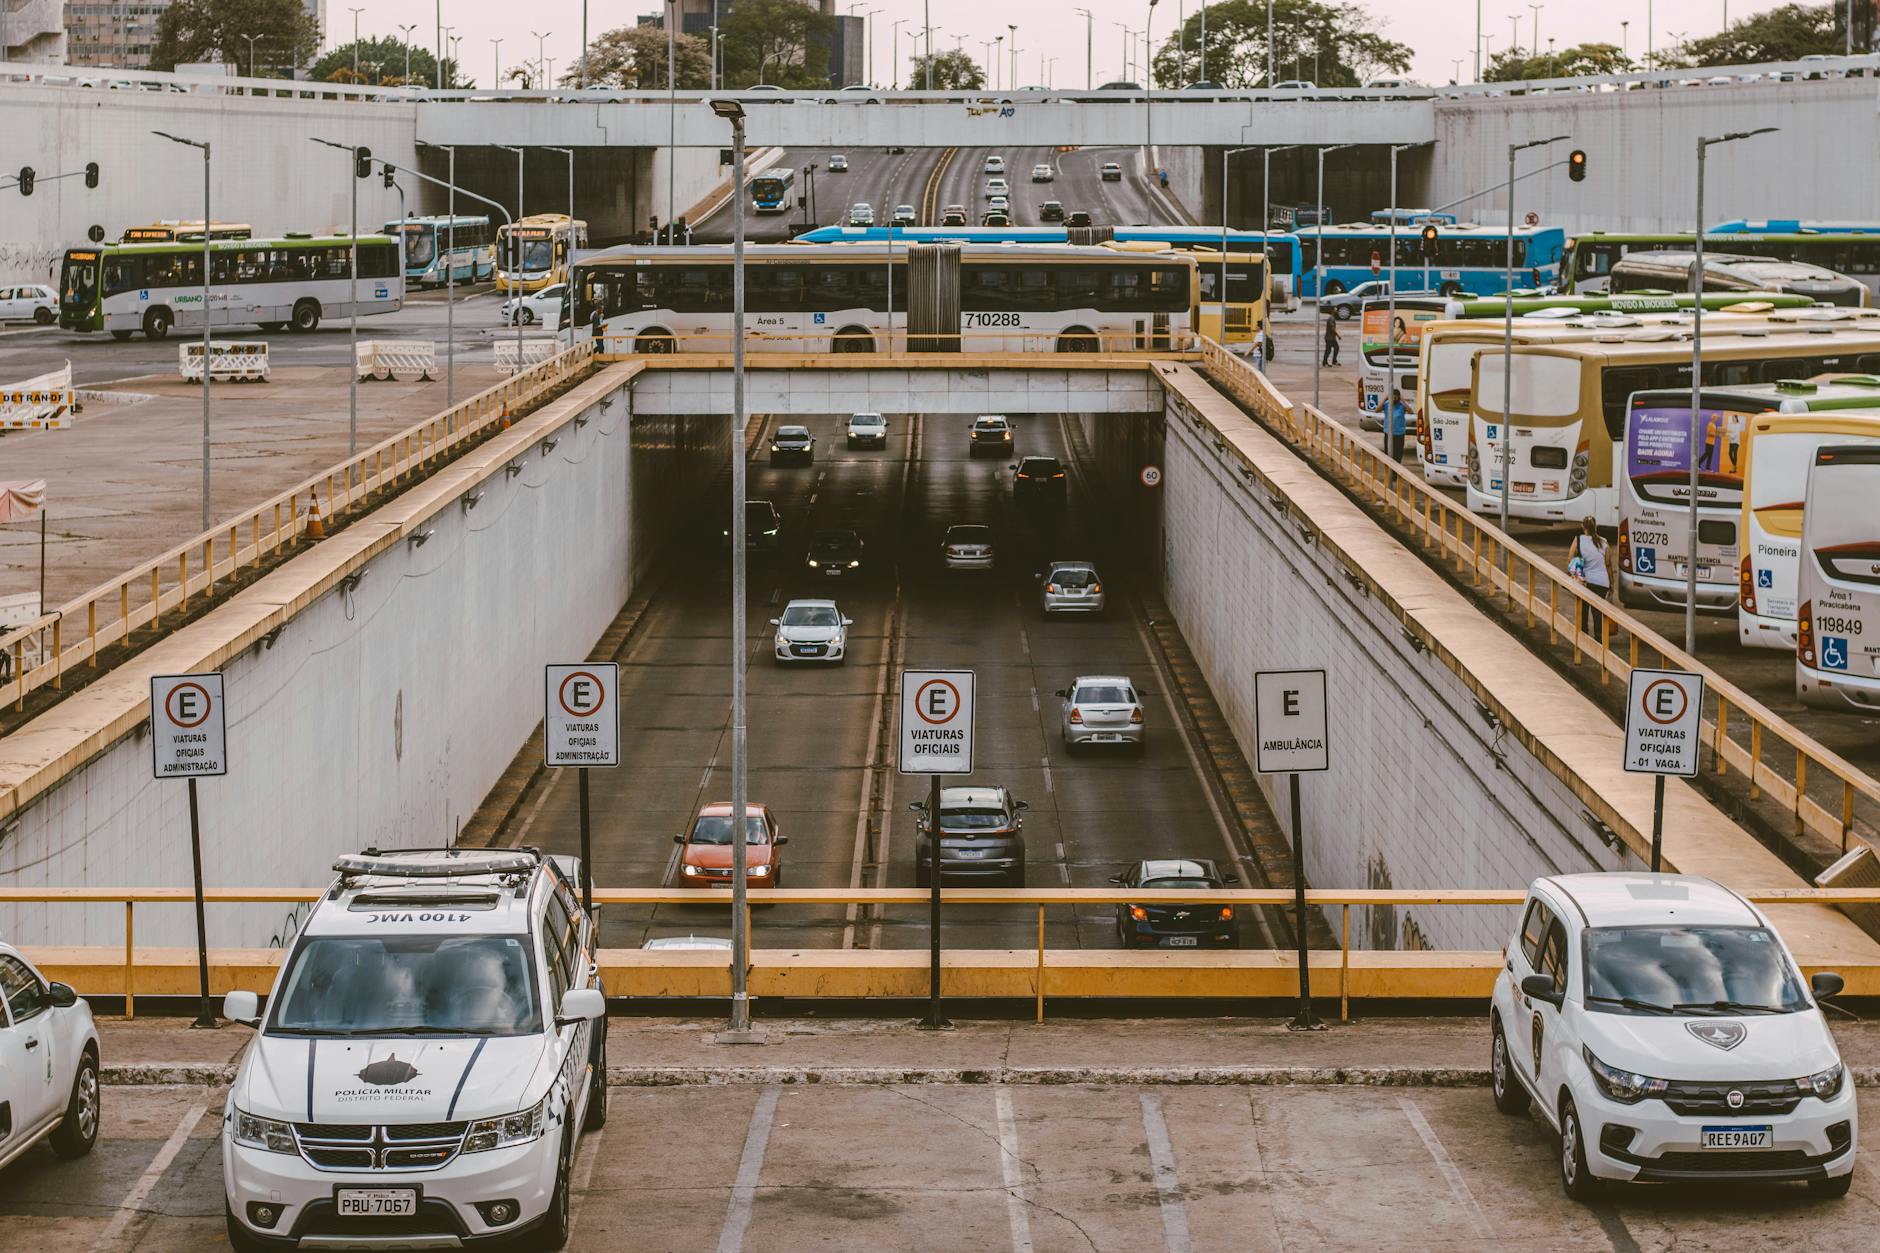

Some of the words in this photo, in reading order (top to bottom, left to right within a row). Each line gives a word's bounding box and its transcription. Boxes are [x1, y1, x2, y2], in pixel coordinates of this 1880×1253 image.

[175, 295, 203, 304] URBANO
[1612, 299, 1637, 310] MOVIDO
[1645, 298, 1678, 308] BIODIESEL
[757, 315, 778, 326] Área
[780, 316, 785, 326] 5
[965, 313, 1021, 326] 710288
[1146, 471, 1157, 480] 60
[1642, 509, 1655, 518] Área
[1632, 531, 1669, 546] 120278
[1759, 544, 1797, 558] Pioneira
[1830, 590, 1847, 600] Área
[1849, 593, 1853, 601] 1
[1820, 599, 1861, 612] Piracicabana
[1817, 616, 1863, 636] 119849
[573, 681, 591, 708] E
[180, 692, 197, 718] E
[929, 689, 947, 715] E
[1283, 690, 1300, 716] E
[1656, 688, 1674, 715] E
[565, 723, 599, 732] VIATURAS
[173, 734, 207, 744] VIATURAS
[911, 729, 964, 740] VIATURAS
[1638, 728, 1686, 740] VIATURAS
[568, 737, 597, 747] OFICIAIS
[1263, 737, 1323, 751] AMBULÂNCIA
[176, 748, 205, 758] OFICIAIS
[914, 743, 960, 754] OFICIAIS
[1640, 743, 1681, 755] OFICIAIS
[556, 750, 610, 762] ADMINISTRAÇÃO
[163, 761, 218, 773] ADMINISTRAÇÃO
[1638, 757, 1649, 767] 01
[1655, 759, 1680, 769] VAGA
[419, 913, 472, 922] 4100
[384, 1087, 432, 1096] MILITAR
[337, 1095, 380, 1103] DISTRITO
[1708, 1132, 1766, 1146] REE9A07
